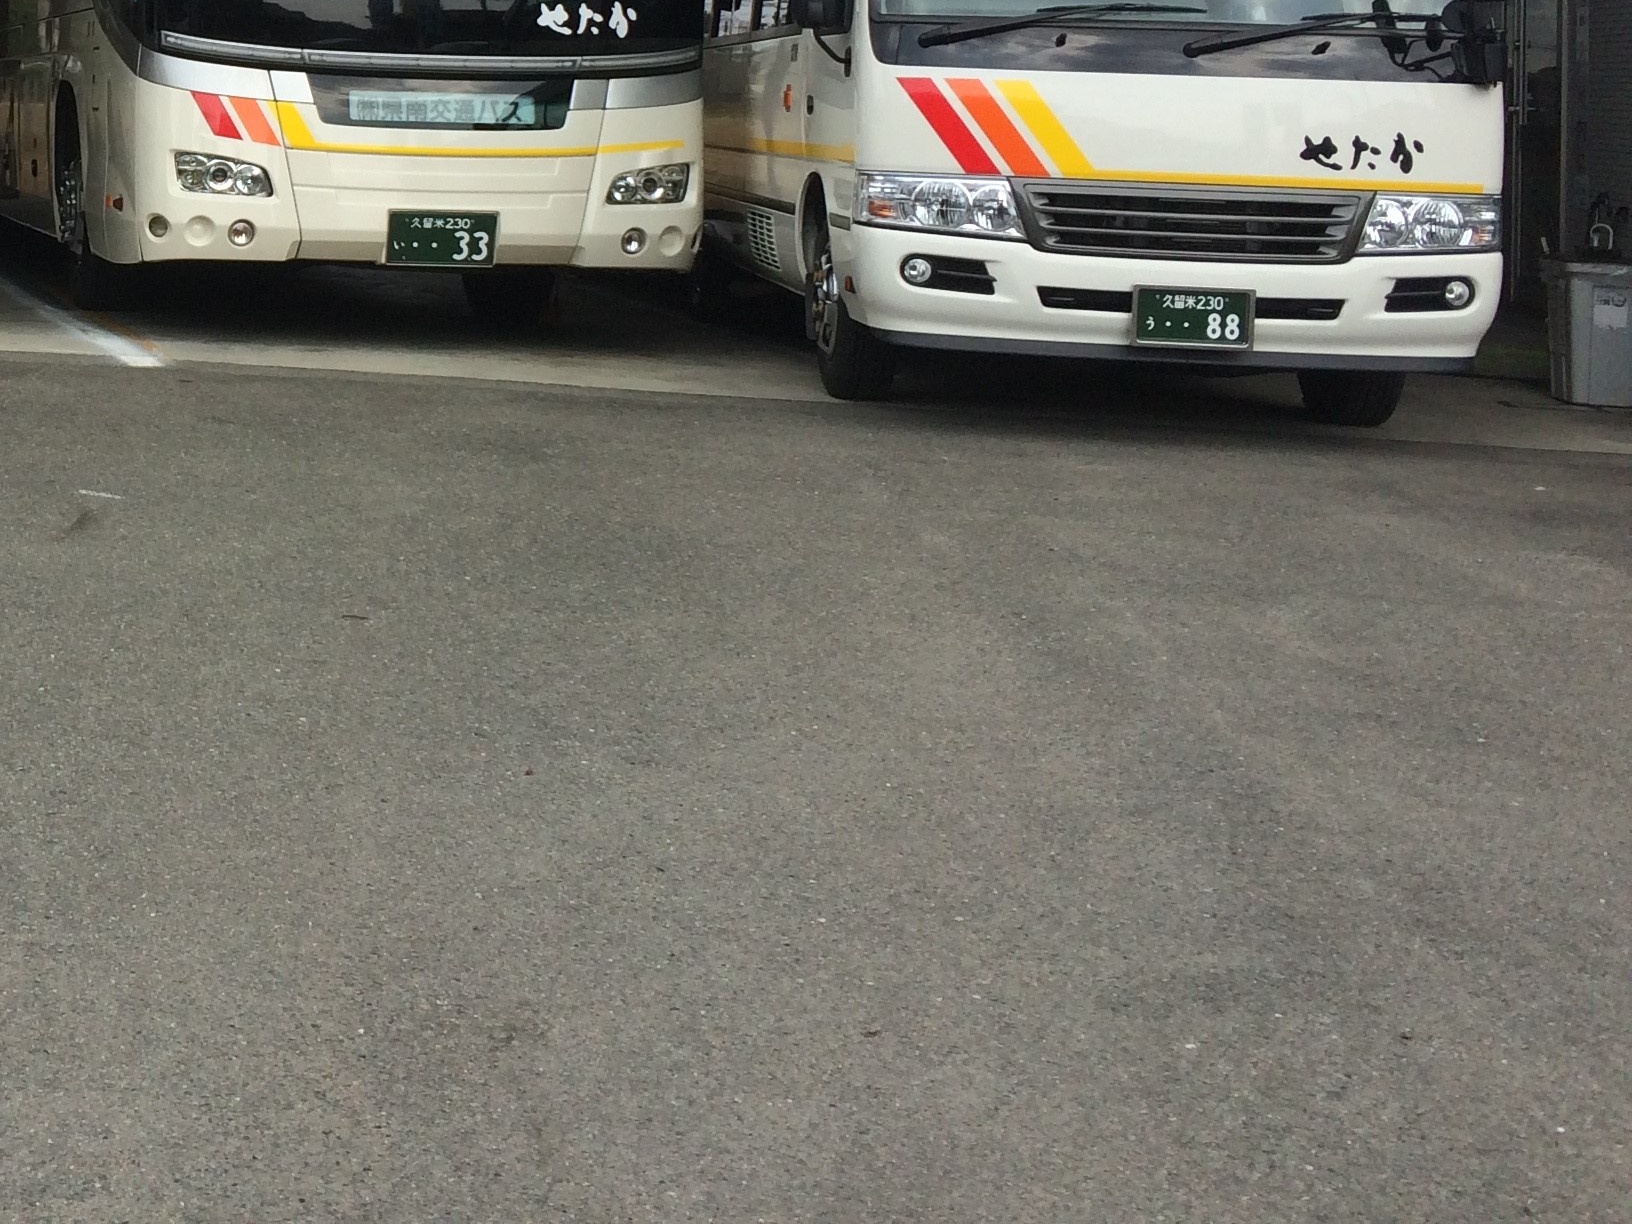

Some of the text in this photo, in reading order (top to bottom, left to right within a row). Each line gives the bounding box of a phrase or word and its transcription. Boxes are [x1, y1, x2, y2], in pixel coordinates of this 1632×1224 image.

[537, 1, 638, 39] せたか
[1300, 132, 1425, 174] せたか
